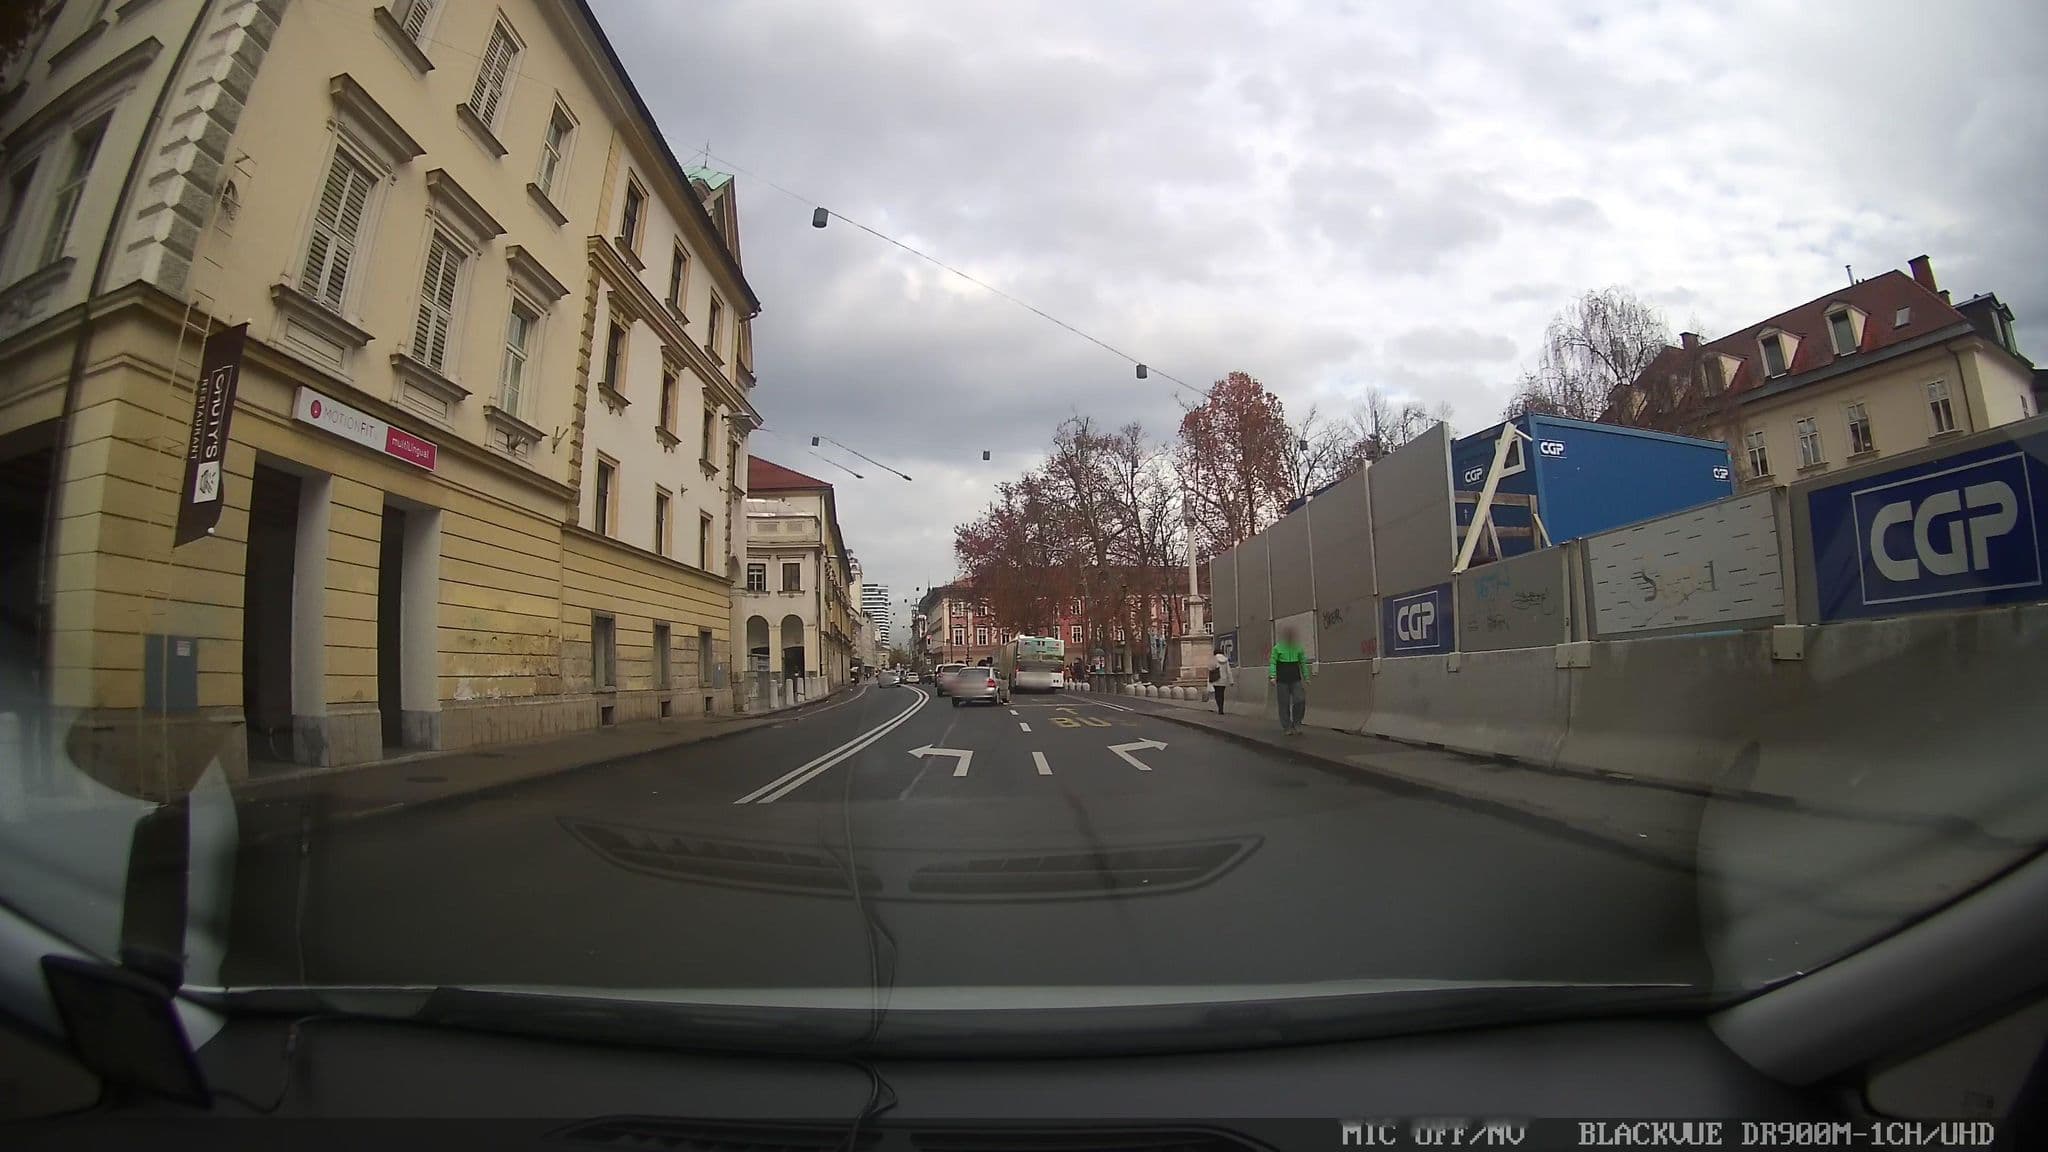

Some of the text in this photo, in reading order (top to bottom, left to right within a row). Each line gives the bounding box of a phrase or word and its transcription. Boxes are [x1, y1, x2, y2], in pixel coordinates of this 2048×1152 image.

[189, 378, 209, 460] RESTAURANT
[1540, 441, 1564, 455] CGP
[1464, 467, 1483, 483] CGP
[1870, 480, 2018, 582] CGP
[1397, 602, 1435, 641] CGP
